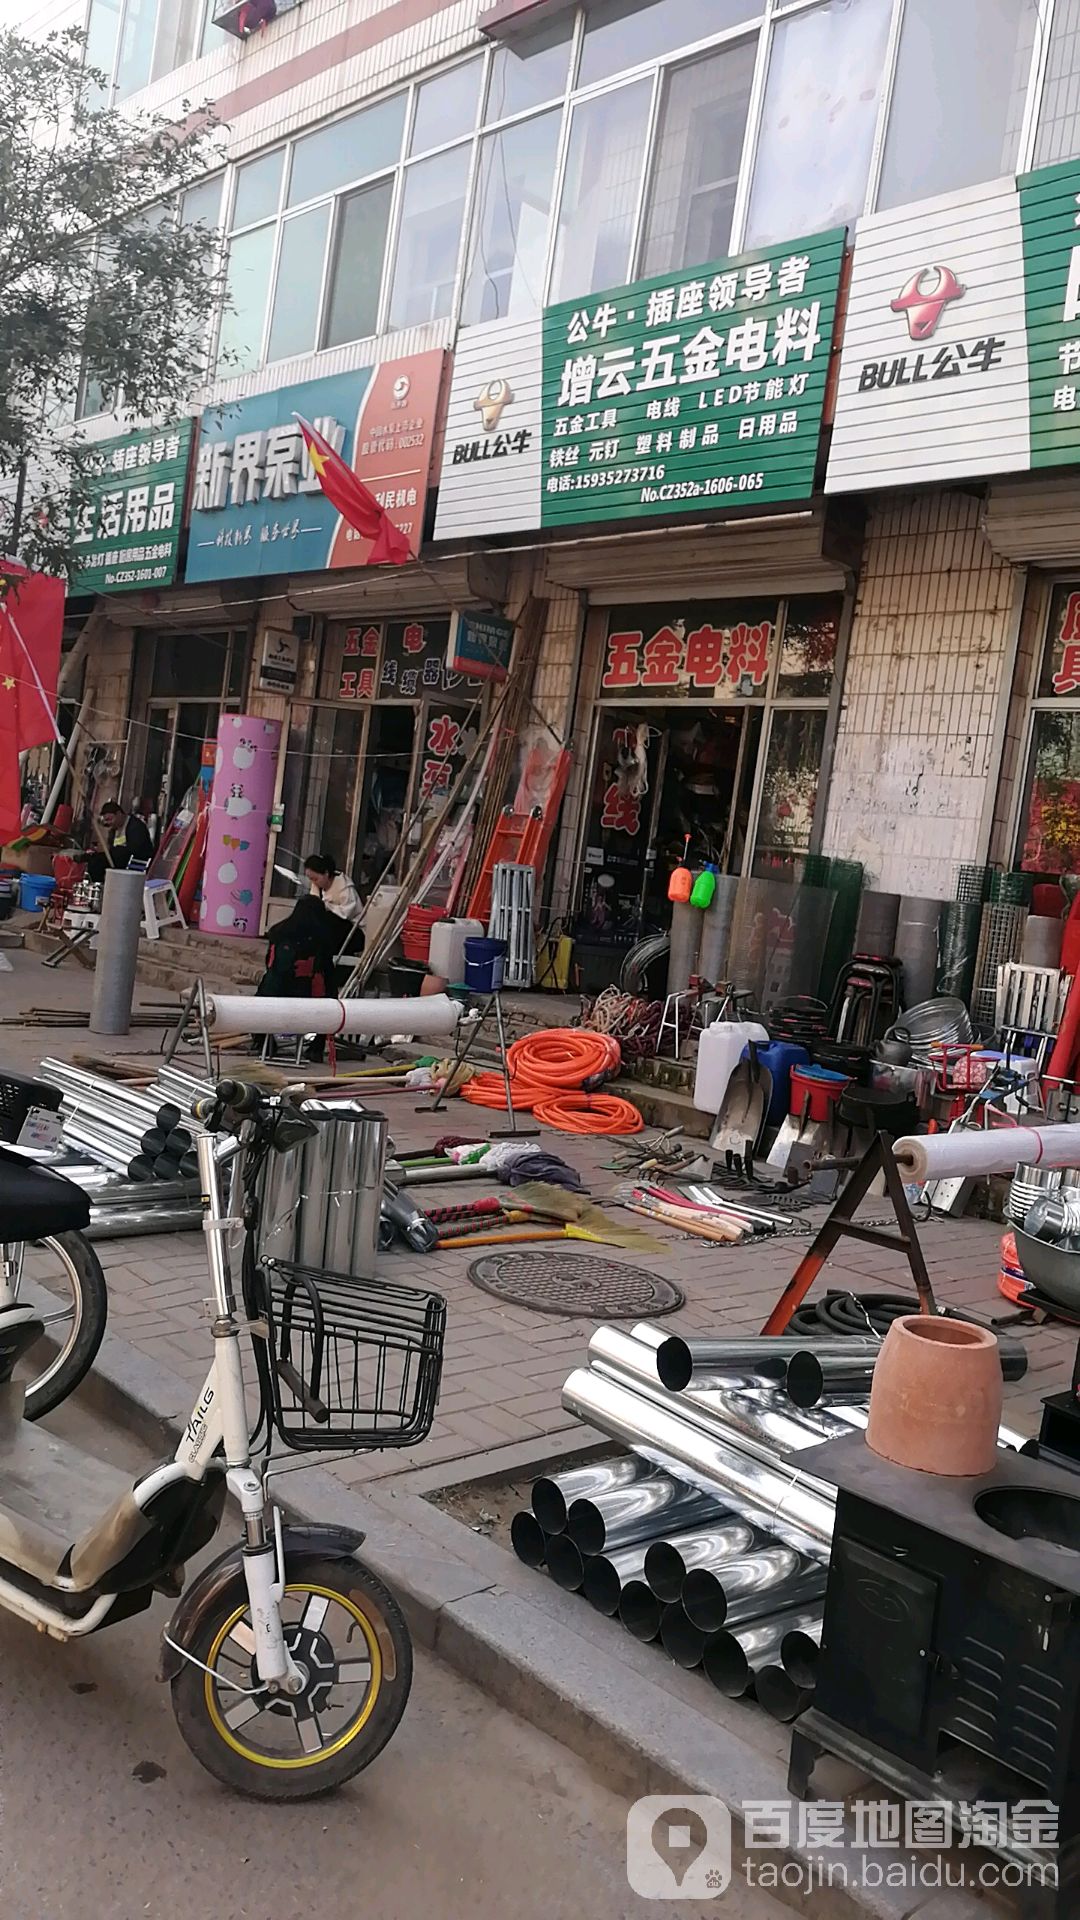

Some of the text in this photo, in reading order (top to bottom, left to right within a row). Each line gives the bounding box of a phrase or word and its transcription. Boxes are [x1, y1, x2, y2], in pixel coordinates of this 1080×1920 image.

[557, 301, 823, 408] 增云五金电料
[549, 411, 798, 469] 铁丝 元钉 塑料制品 日用品
[553, 408, 618, 437] 五金工具
[646, 396, 681, 421] 电线
[640, 472, 764, 503] No.CZ352a-1606-065
[343, 626, 380, 657] 五金
[602, 620, 773, 688] 五金电料
[339, 667, 375, 698] 工具
[186, 1386, 214, 1442] TAILG
